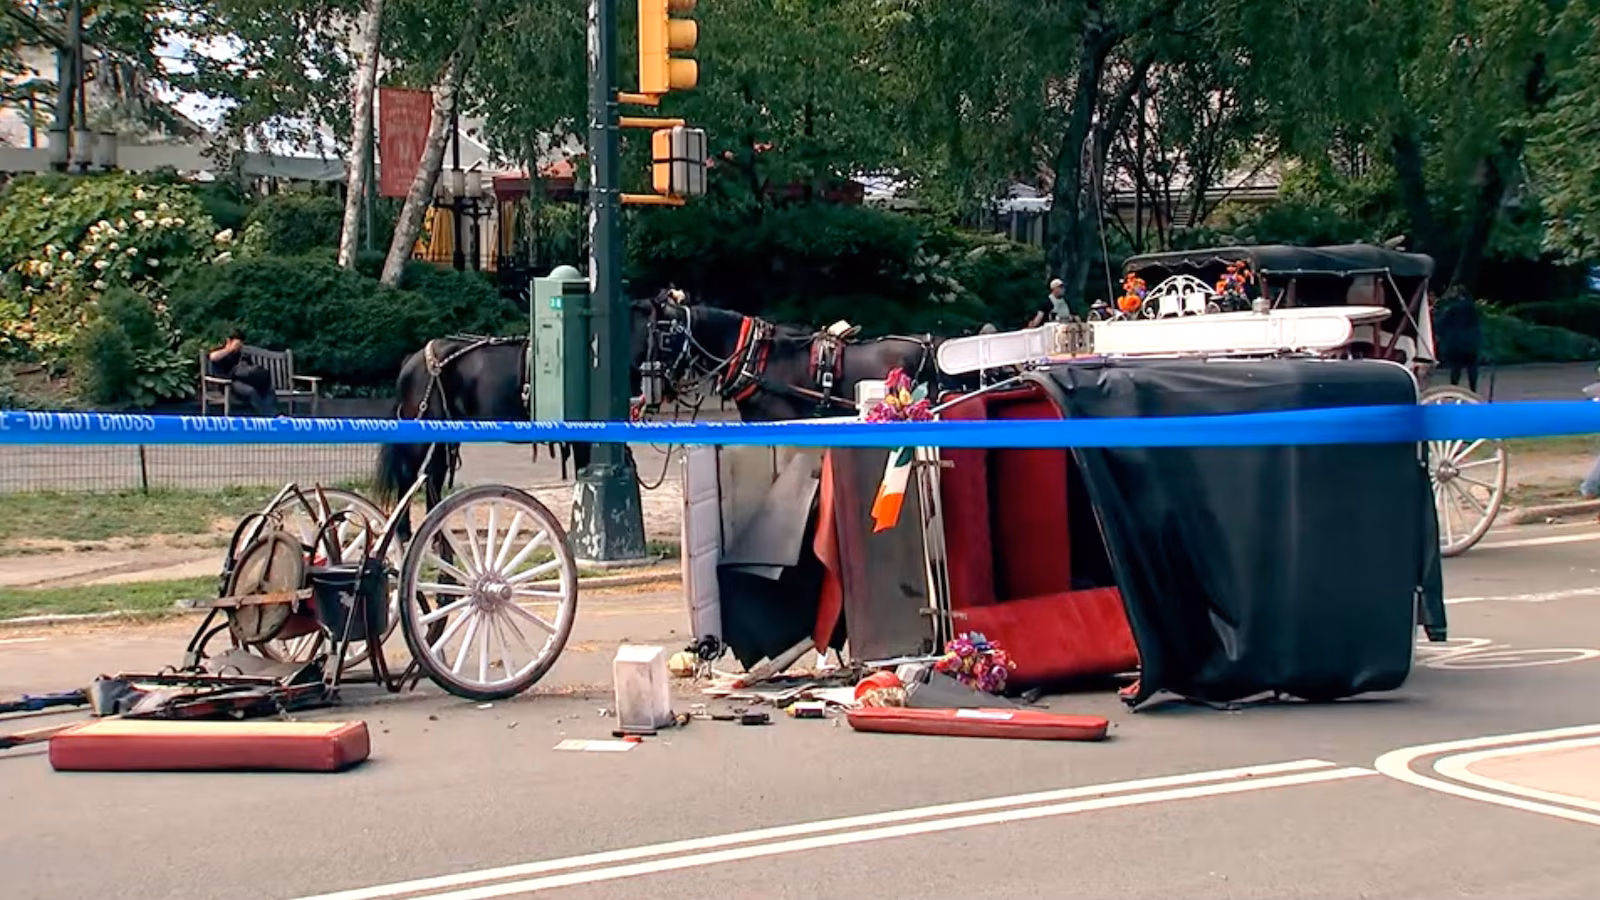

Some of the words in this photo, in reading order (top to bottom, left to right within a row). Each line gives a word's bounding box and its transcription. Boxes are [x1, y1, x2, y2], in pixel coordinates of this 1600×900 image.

[28, 411, 53, 430] DO
[57, 412, 90, 431] NOT
[98, 413, 156, 431] CROSS
